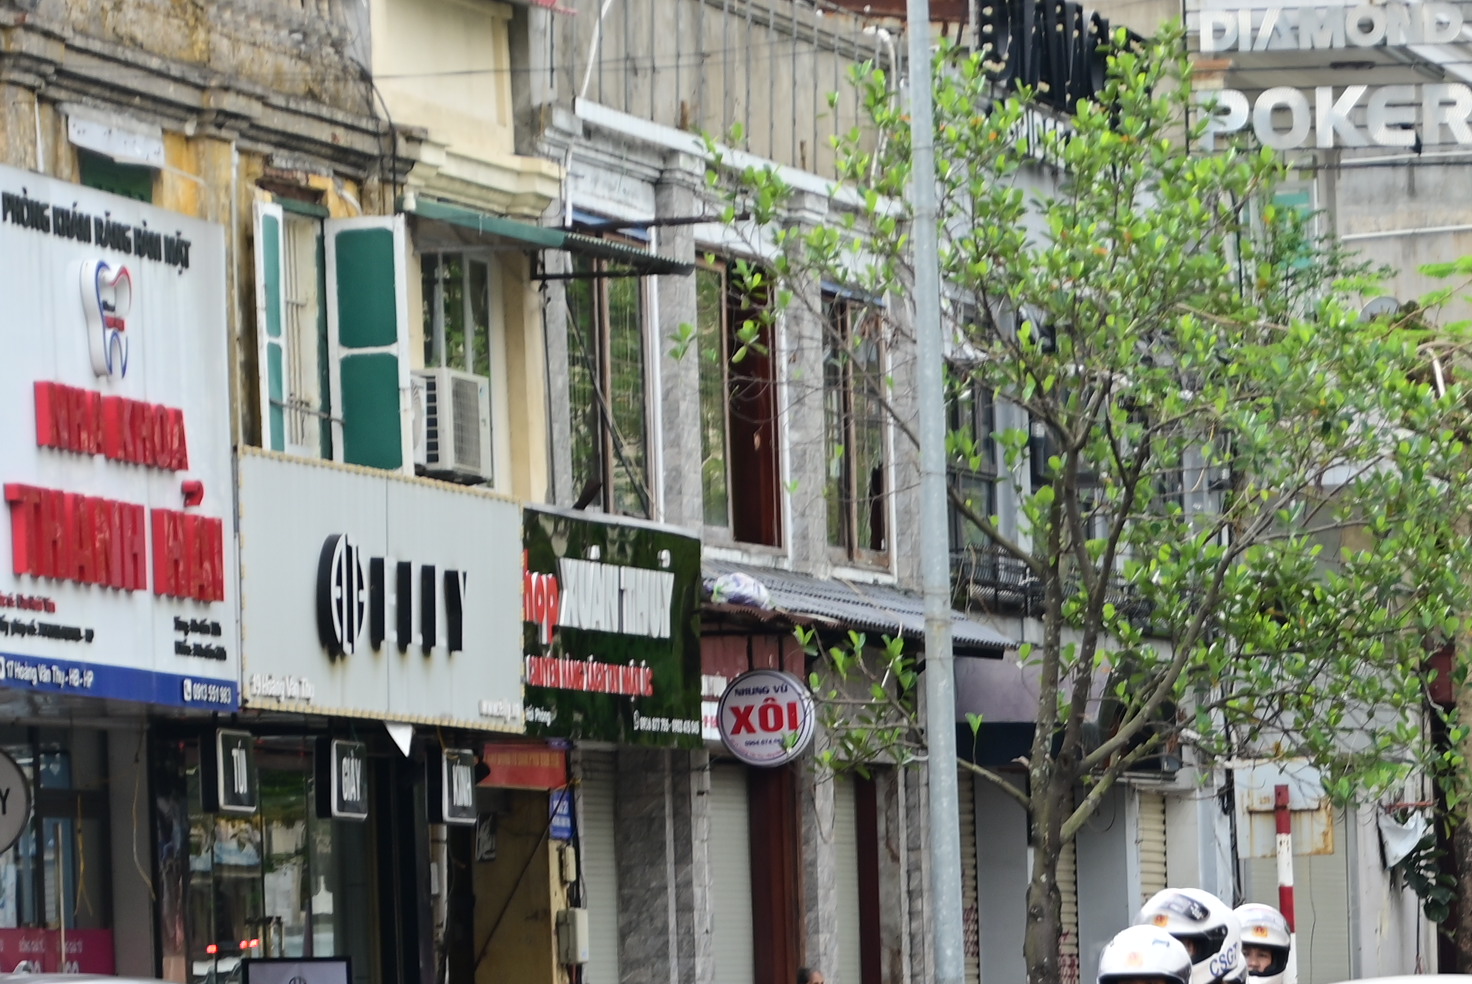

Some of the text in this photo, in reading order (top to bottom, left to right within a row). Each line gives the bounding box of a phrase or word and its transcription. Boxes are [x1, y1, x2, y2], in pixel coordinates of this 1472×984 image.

[1200, 2, 1463, 52] DIAMOND
[52, 202, 92, 243] KHÁM
[34, 381, 189, 471] NHA KHOA
[4, 480, 225, 603] THANH HẢI
[729, 697, 799, 735] XÔI
[231, 740, 248, 795] TÚI
